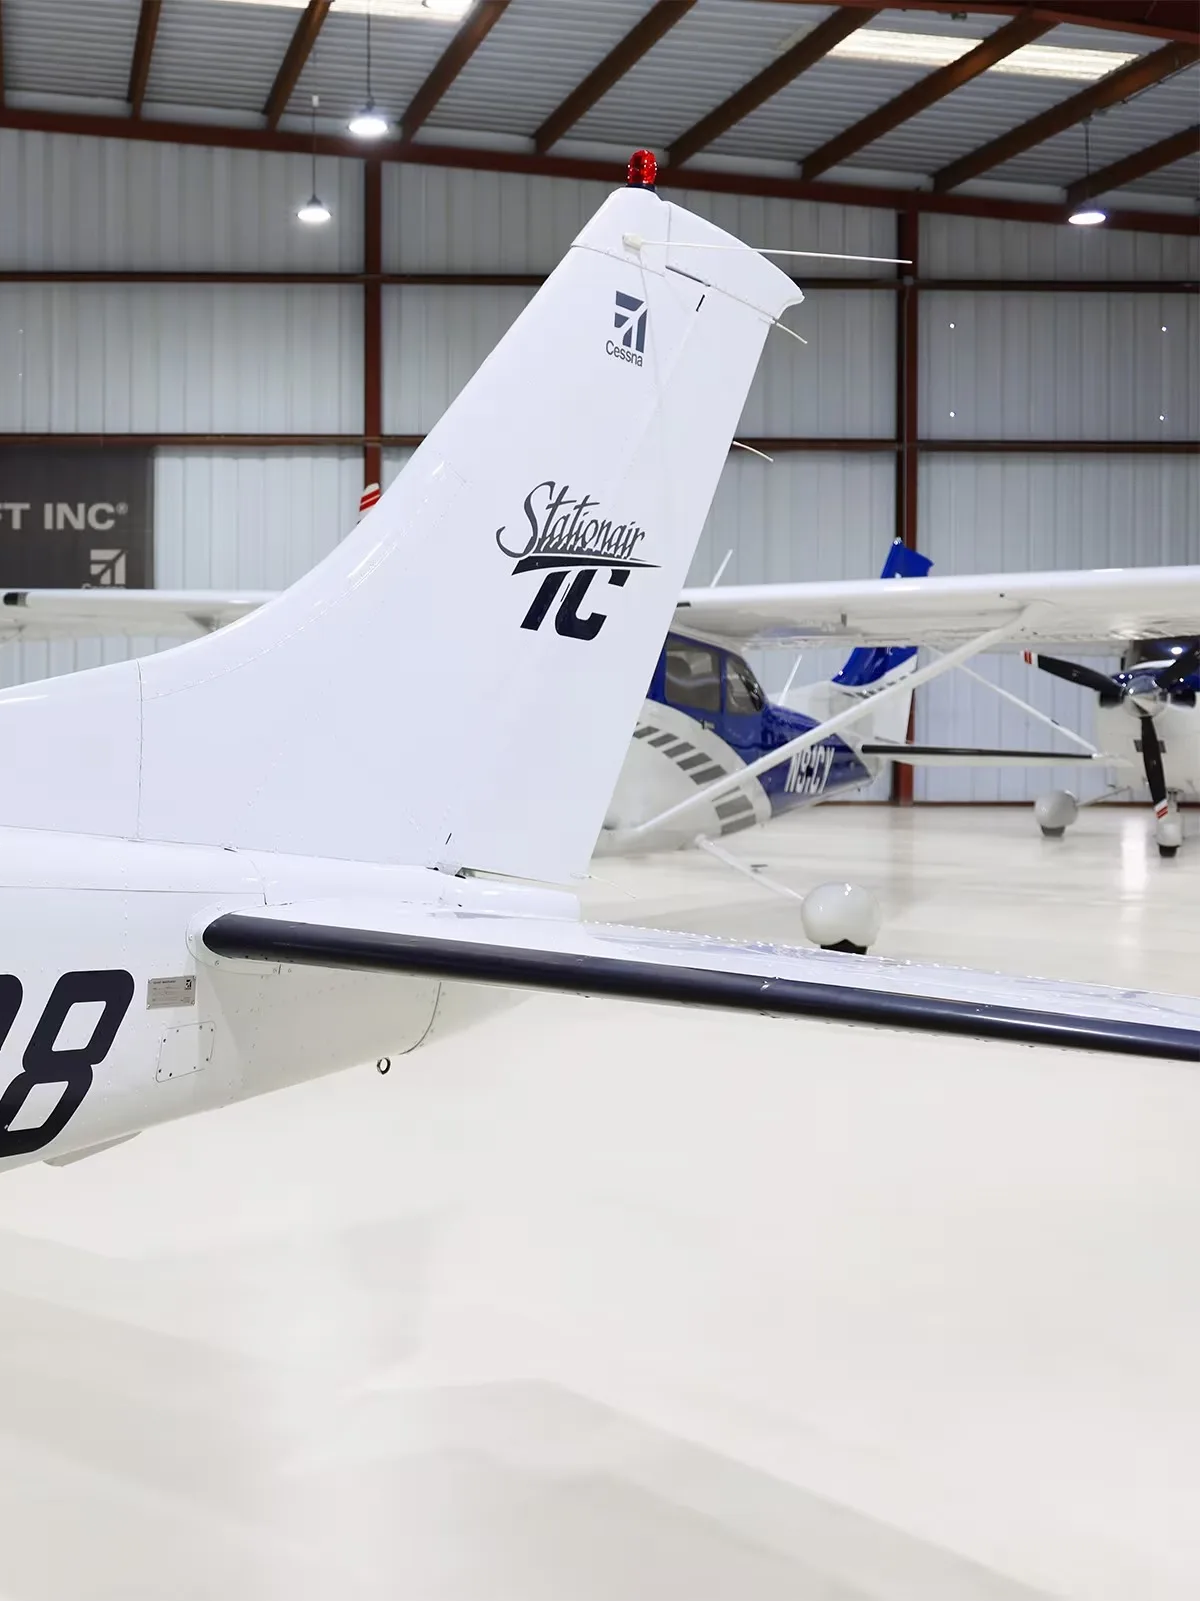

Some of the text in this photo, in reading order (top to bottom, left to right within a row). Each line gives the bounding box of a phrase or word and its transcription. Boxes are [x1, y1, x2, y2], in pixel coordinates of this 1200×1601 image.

[605, 339, 643, 367] Cessna
[496, 480, 646, 559] Stationair
[511, 556, 662, 641] TC
